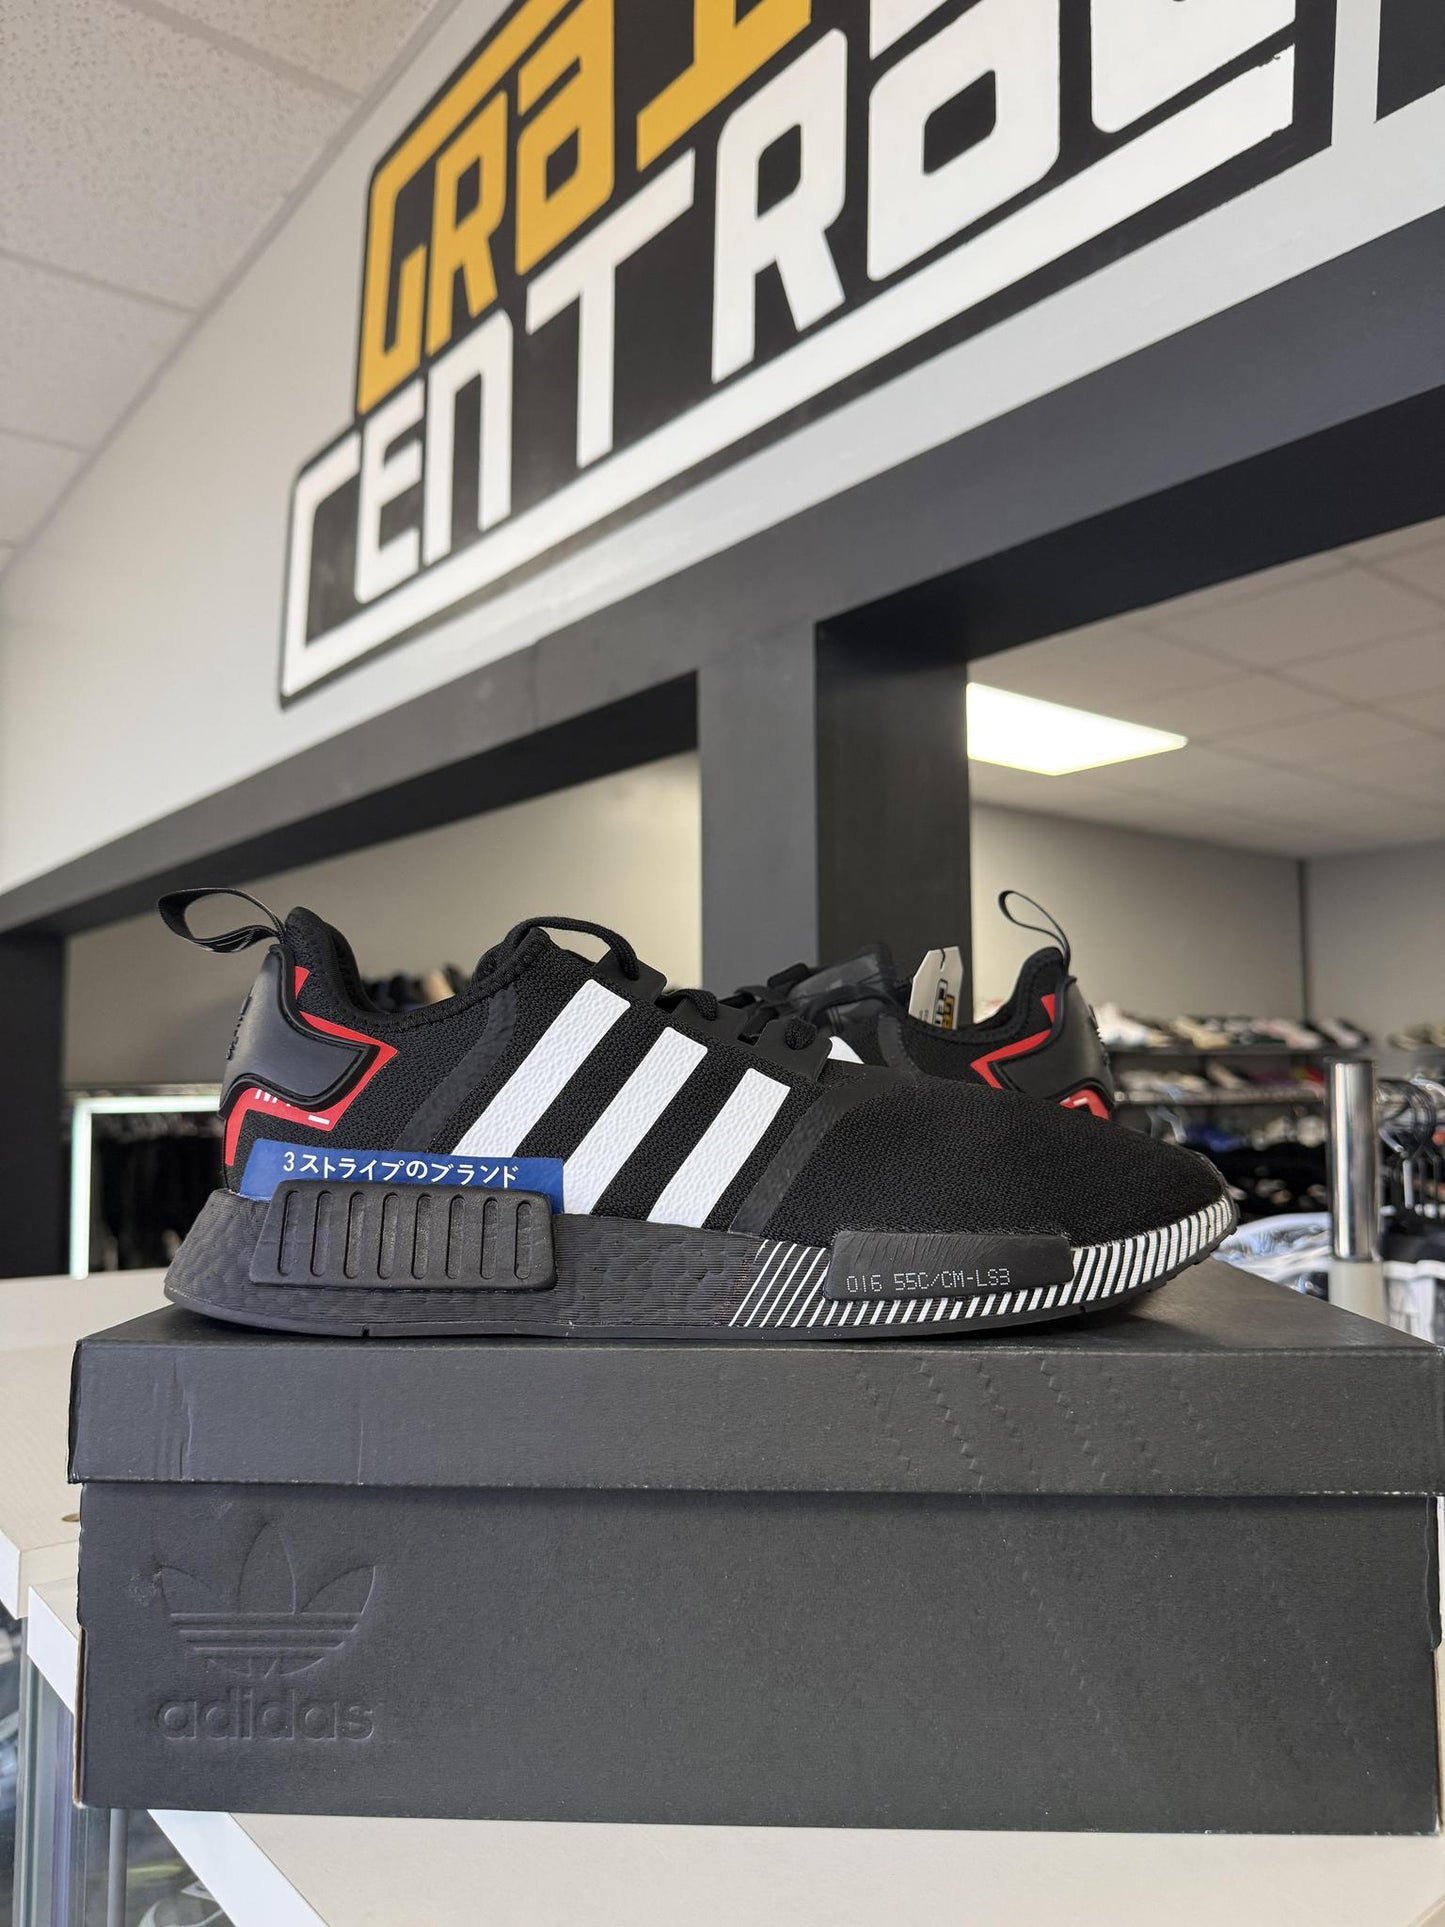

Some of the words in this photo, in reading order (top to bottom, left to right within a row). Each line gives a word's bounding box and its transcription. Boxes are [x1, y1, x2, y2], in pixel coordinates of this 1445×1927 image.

[282, 1151, 520, 1189] 3ストライプのブランド
[846, 1273, 883, 1293] 016
[157, 1686, 375, 1742] adidas
